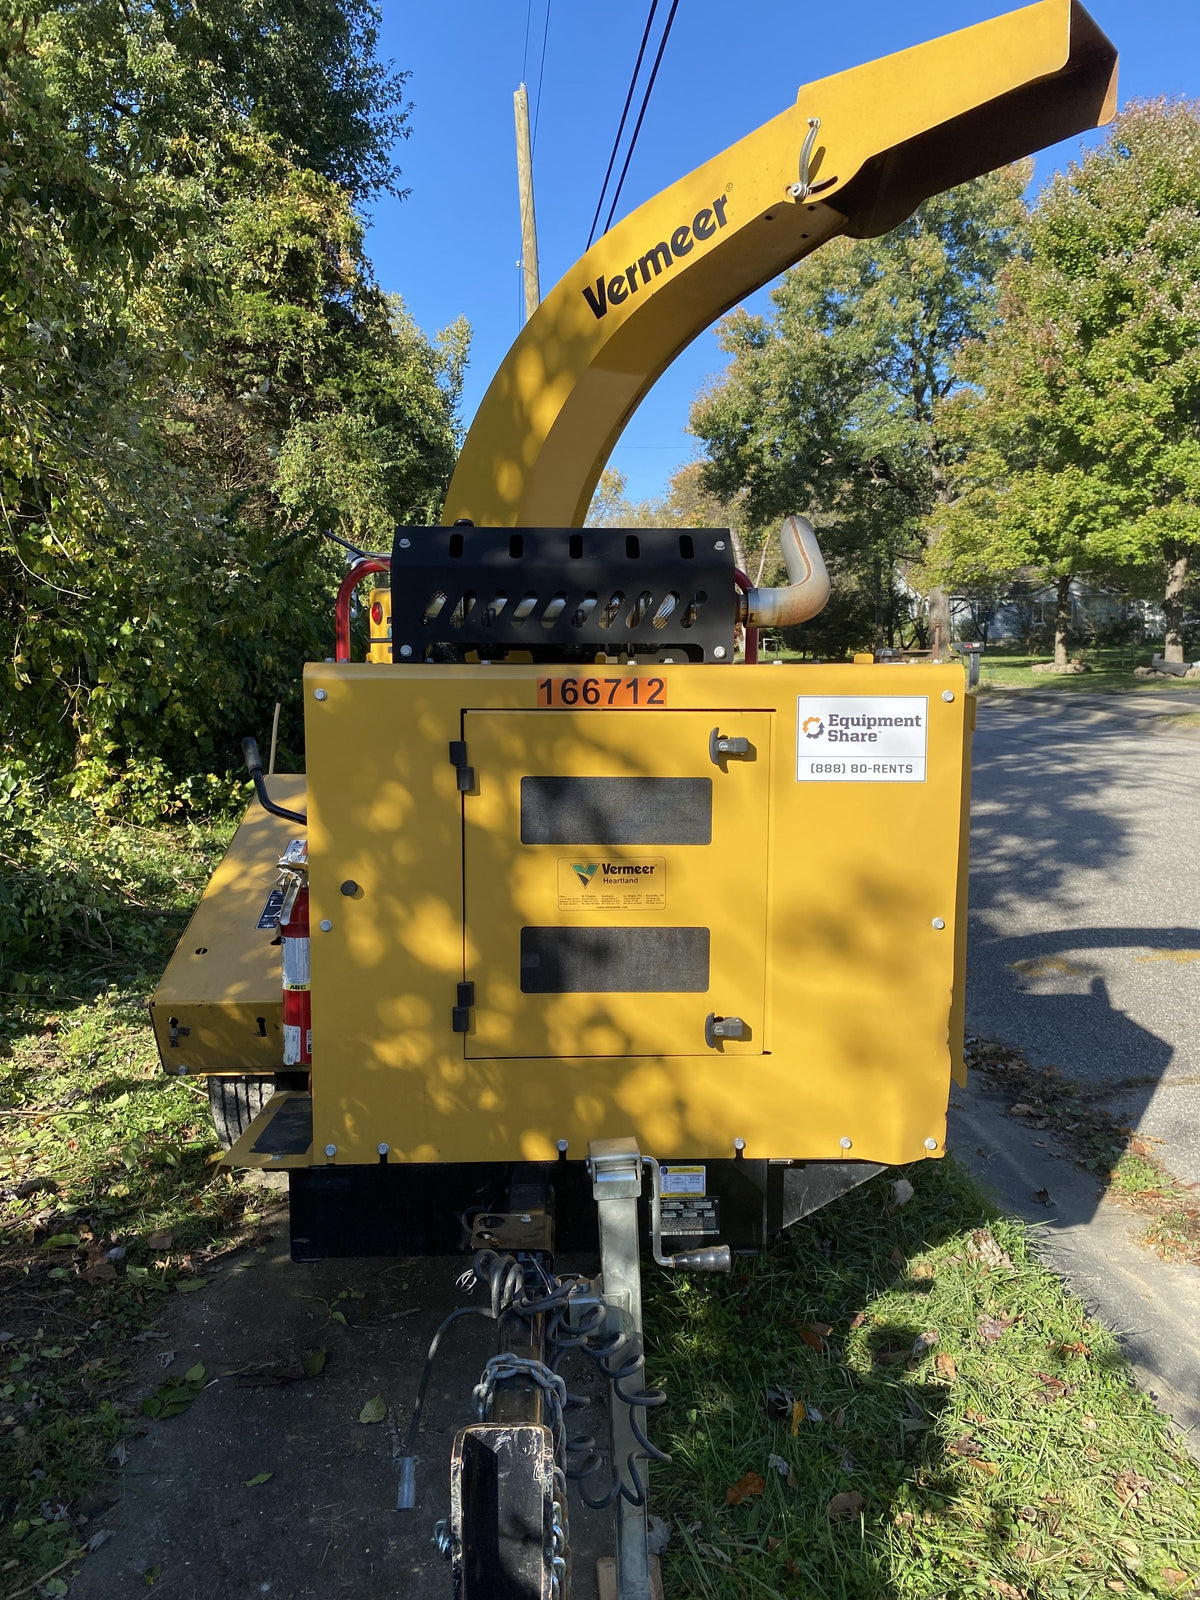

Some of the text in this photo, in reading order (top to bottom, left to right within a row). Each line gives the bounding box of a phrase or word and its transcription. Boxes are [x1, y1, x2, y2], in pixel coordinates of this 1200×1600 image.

[582, 194, 728, 320] Vermeer
[540, 678, 664, 705] 166712
[828, 714, 922, 730] Equipment
[828, 730, 878, 742] Share
[810, 763, 913, 774] (888) 80-RENTS
[601, 863, 655, 875] Vermeer
